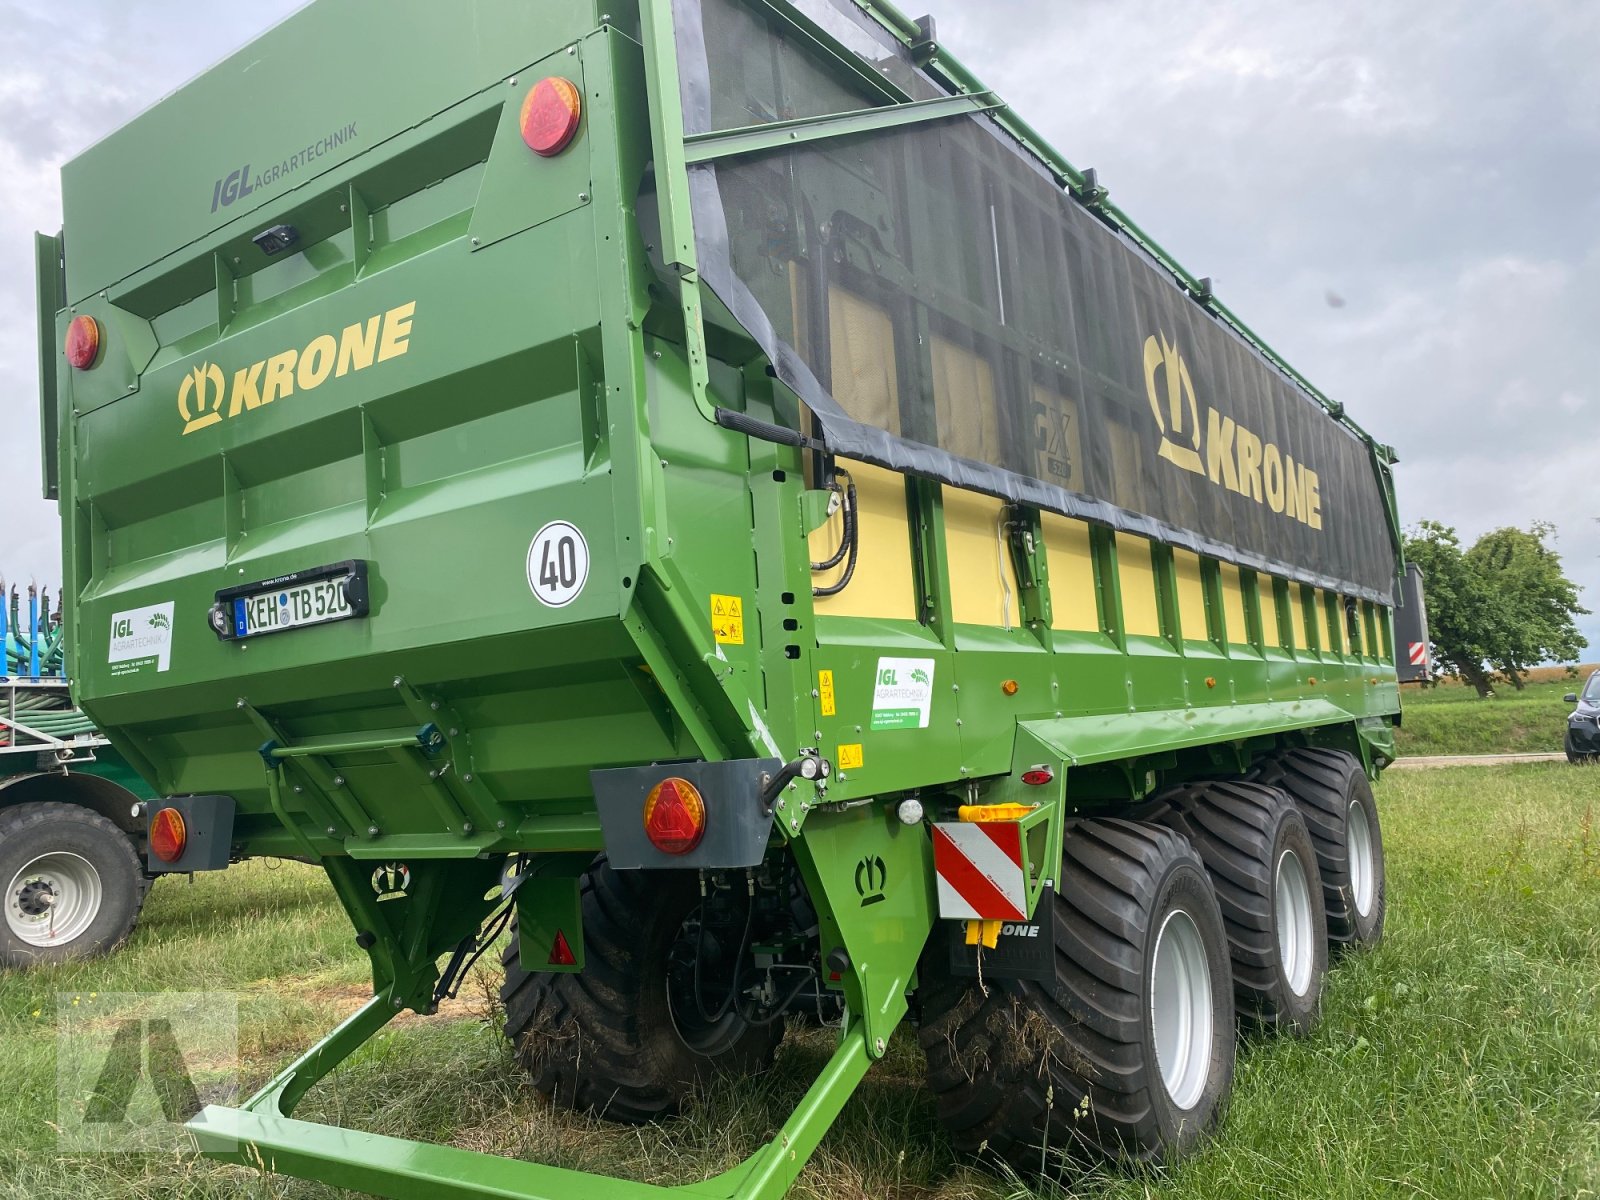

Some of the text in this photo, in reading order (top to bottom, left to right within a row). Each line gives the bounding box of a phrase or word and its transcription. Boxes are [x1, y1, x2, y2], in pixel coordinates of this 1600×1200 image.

[211, 121, 358, 214] IGL AGRARTECHNIK
[228, 300, 416, 418] KRONE
[1207, 406, 1322, 531] KRONE
[539, 535, 577, 592] 40
[113, 619, 134, 639] IGL
[239, 622, 244, 630] D
[246, 596, 279, 630] KEH
[290, 588, 312, 621] TB
[878, 669, 898, 686] IGL
[999, 924, 1040, 938] ONE
